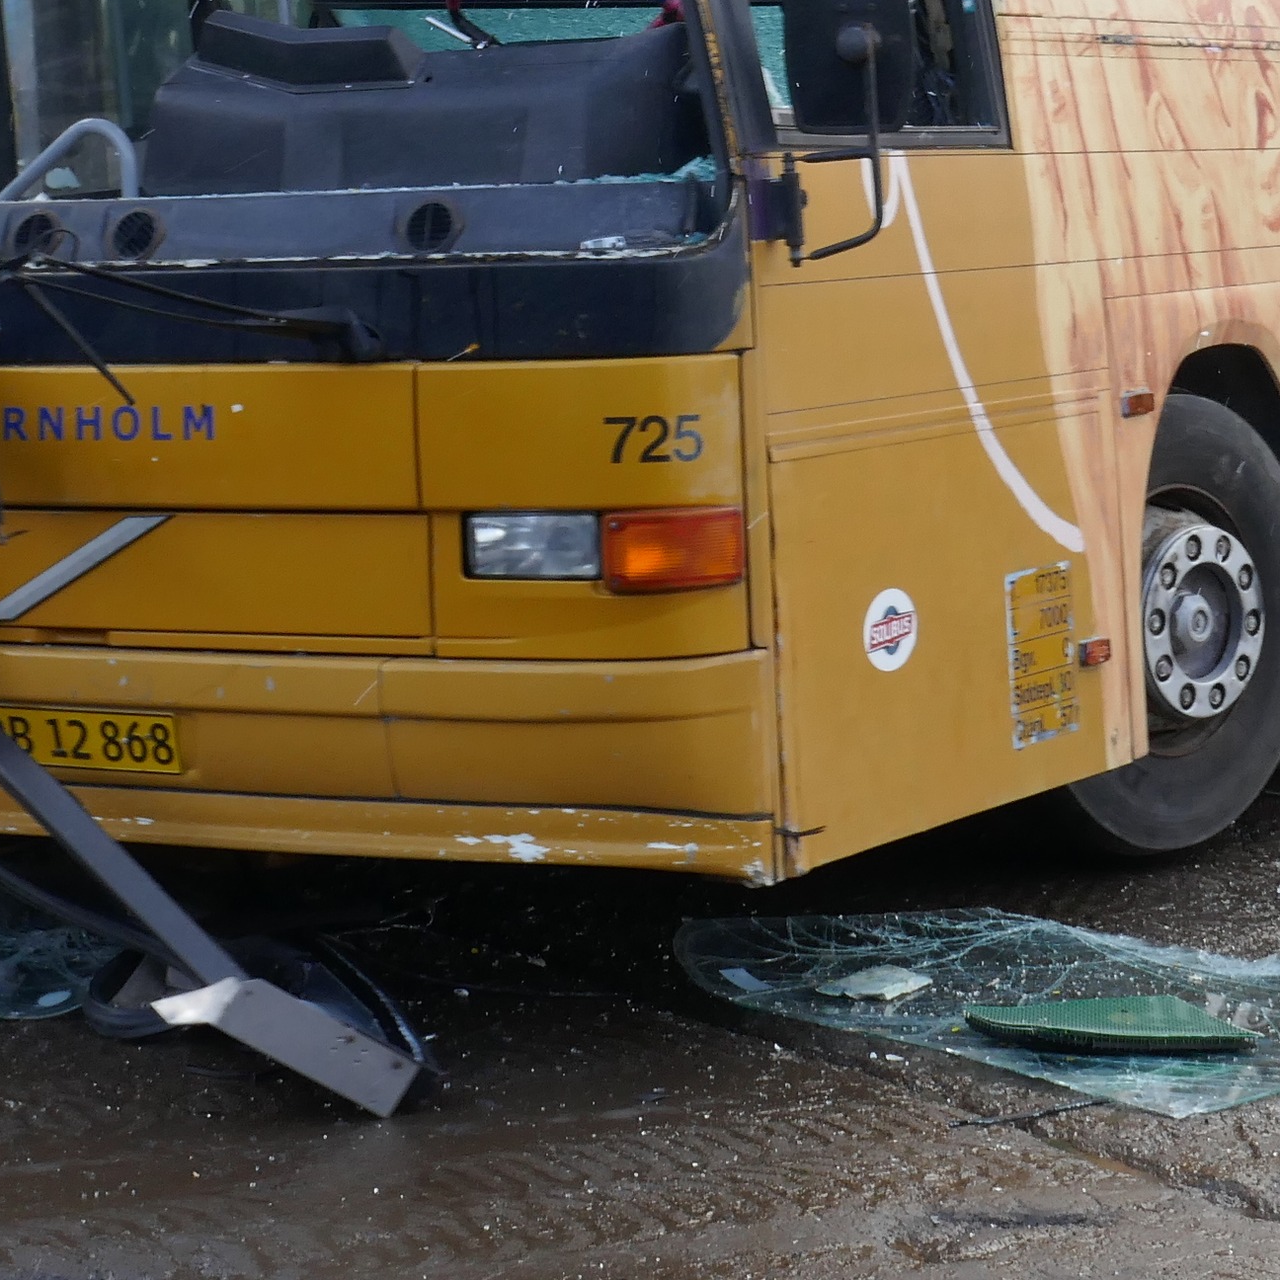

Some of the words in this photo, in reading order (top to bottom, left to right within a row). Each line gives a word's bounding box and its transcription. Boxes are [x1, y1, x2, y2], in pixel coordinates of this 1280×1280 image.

[603, 414, 704, 464] 725
[47, 719, 91, 761] 12
[100, 720, 174, 765] 868
